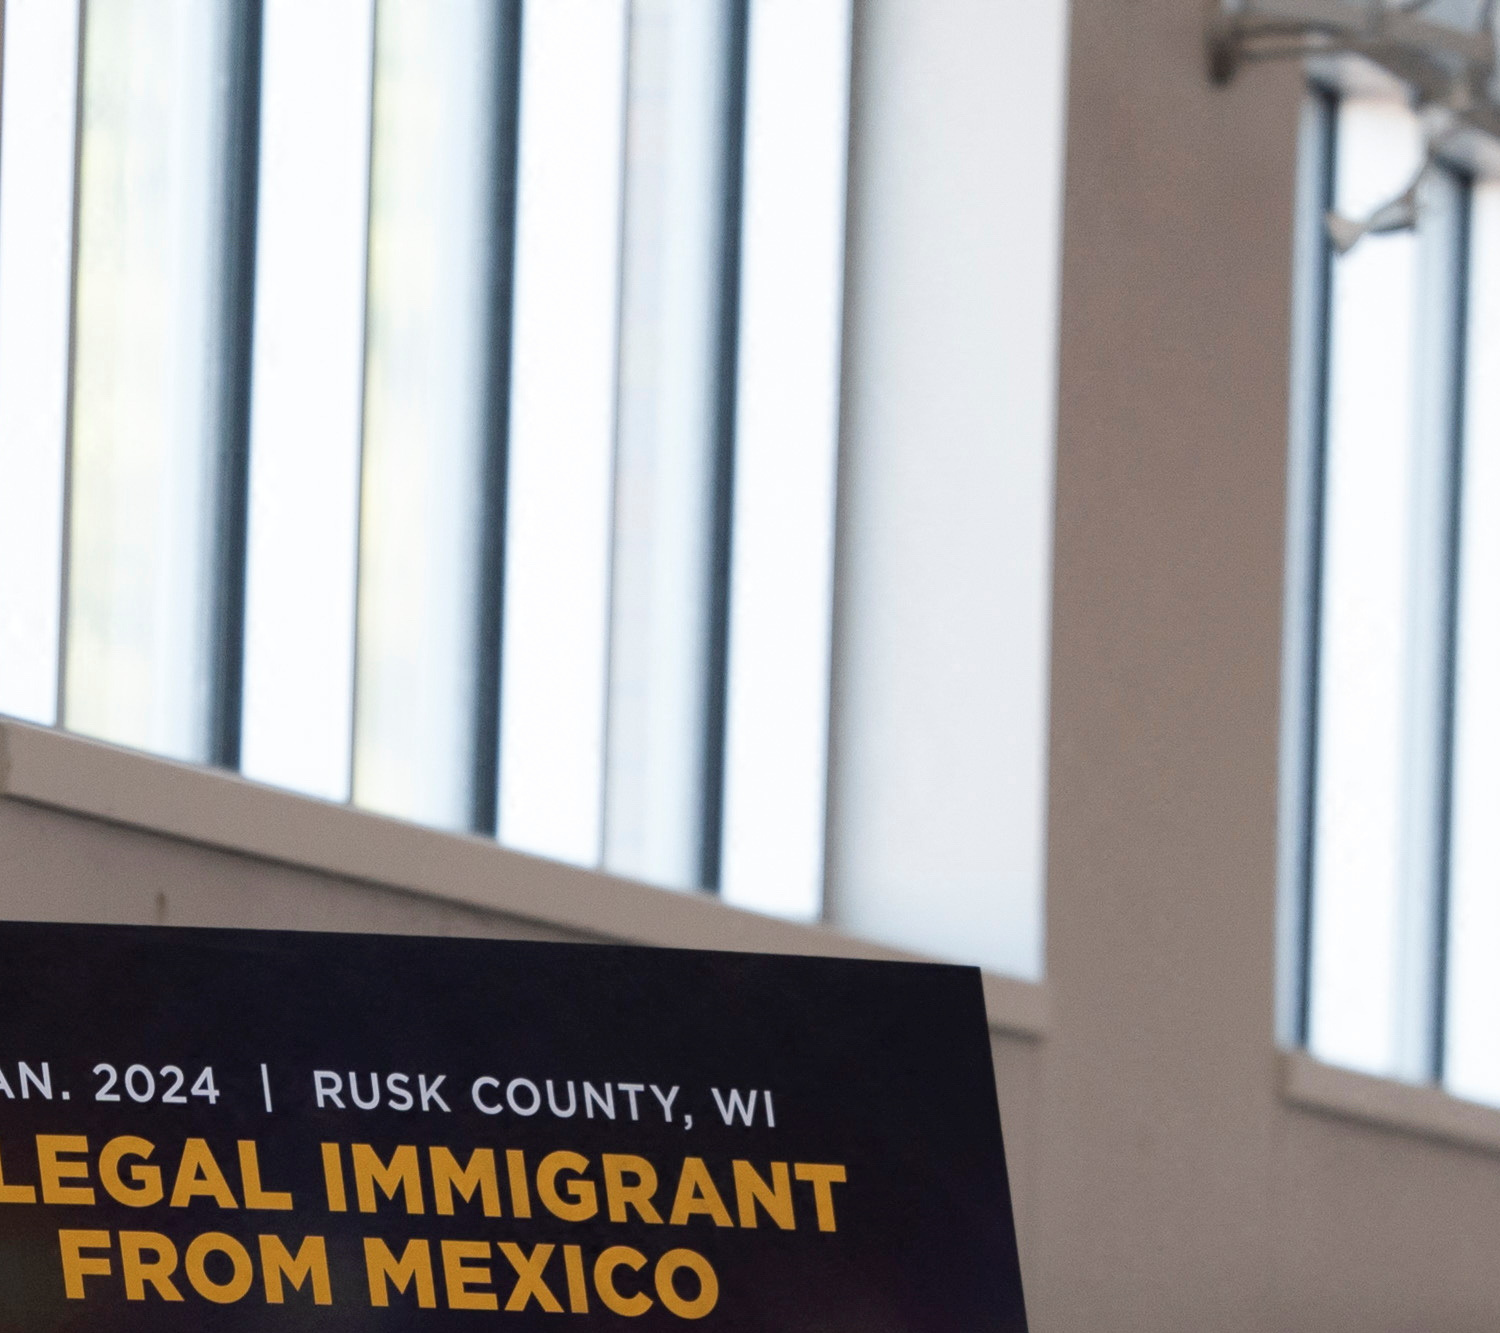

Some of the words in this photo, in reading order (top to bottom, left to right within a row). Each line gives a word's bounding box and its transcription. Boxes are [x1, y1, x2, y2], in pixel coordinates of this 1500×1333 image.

[91, 1061, 222, 1106] 2024
[311, 1068, 452, 1114] RUSK
[469, 1074, 695, 1132] COUNTY,
[709, 1086, 777, 1129] WI
[319, 1141, 850, 1233] IMMIGRANT
[56, 1227, 334, 1307] FROM
[361, 1235, 721, 1321] MEXICO
